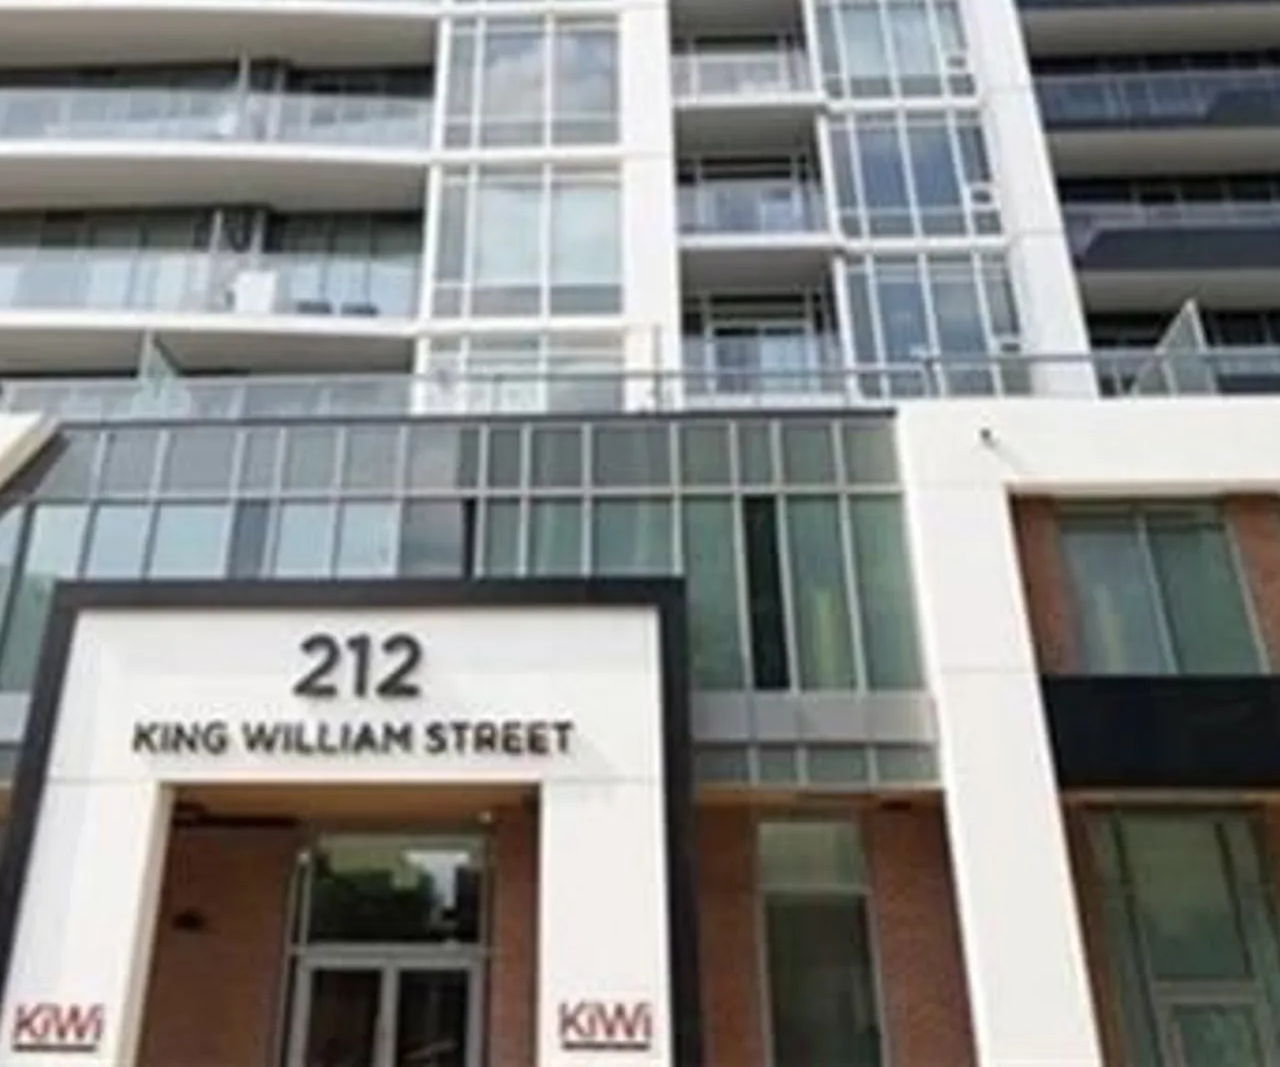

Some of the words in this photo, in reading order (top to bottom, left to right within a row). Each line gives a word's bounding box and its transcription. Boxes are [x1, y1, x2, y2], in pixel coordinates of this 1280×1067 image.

[292, 632, 422, 698] 212
[132, 721, 229, 755] KING
[241, 721, 413, 755] WILLIAM
[425, 721, 575, 755] STREET
